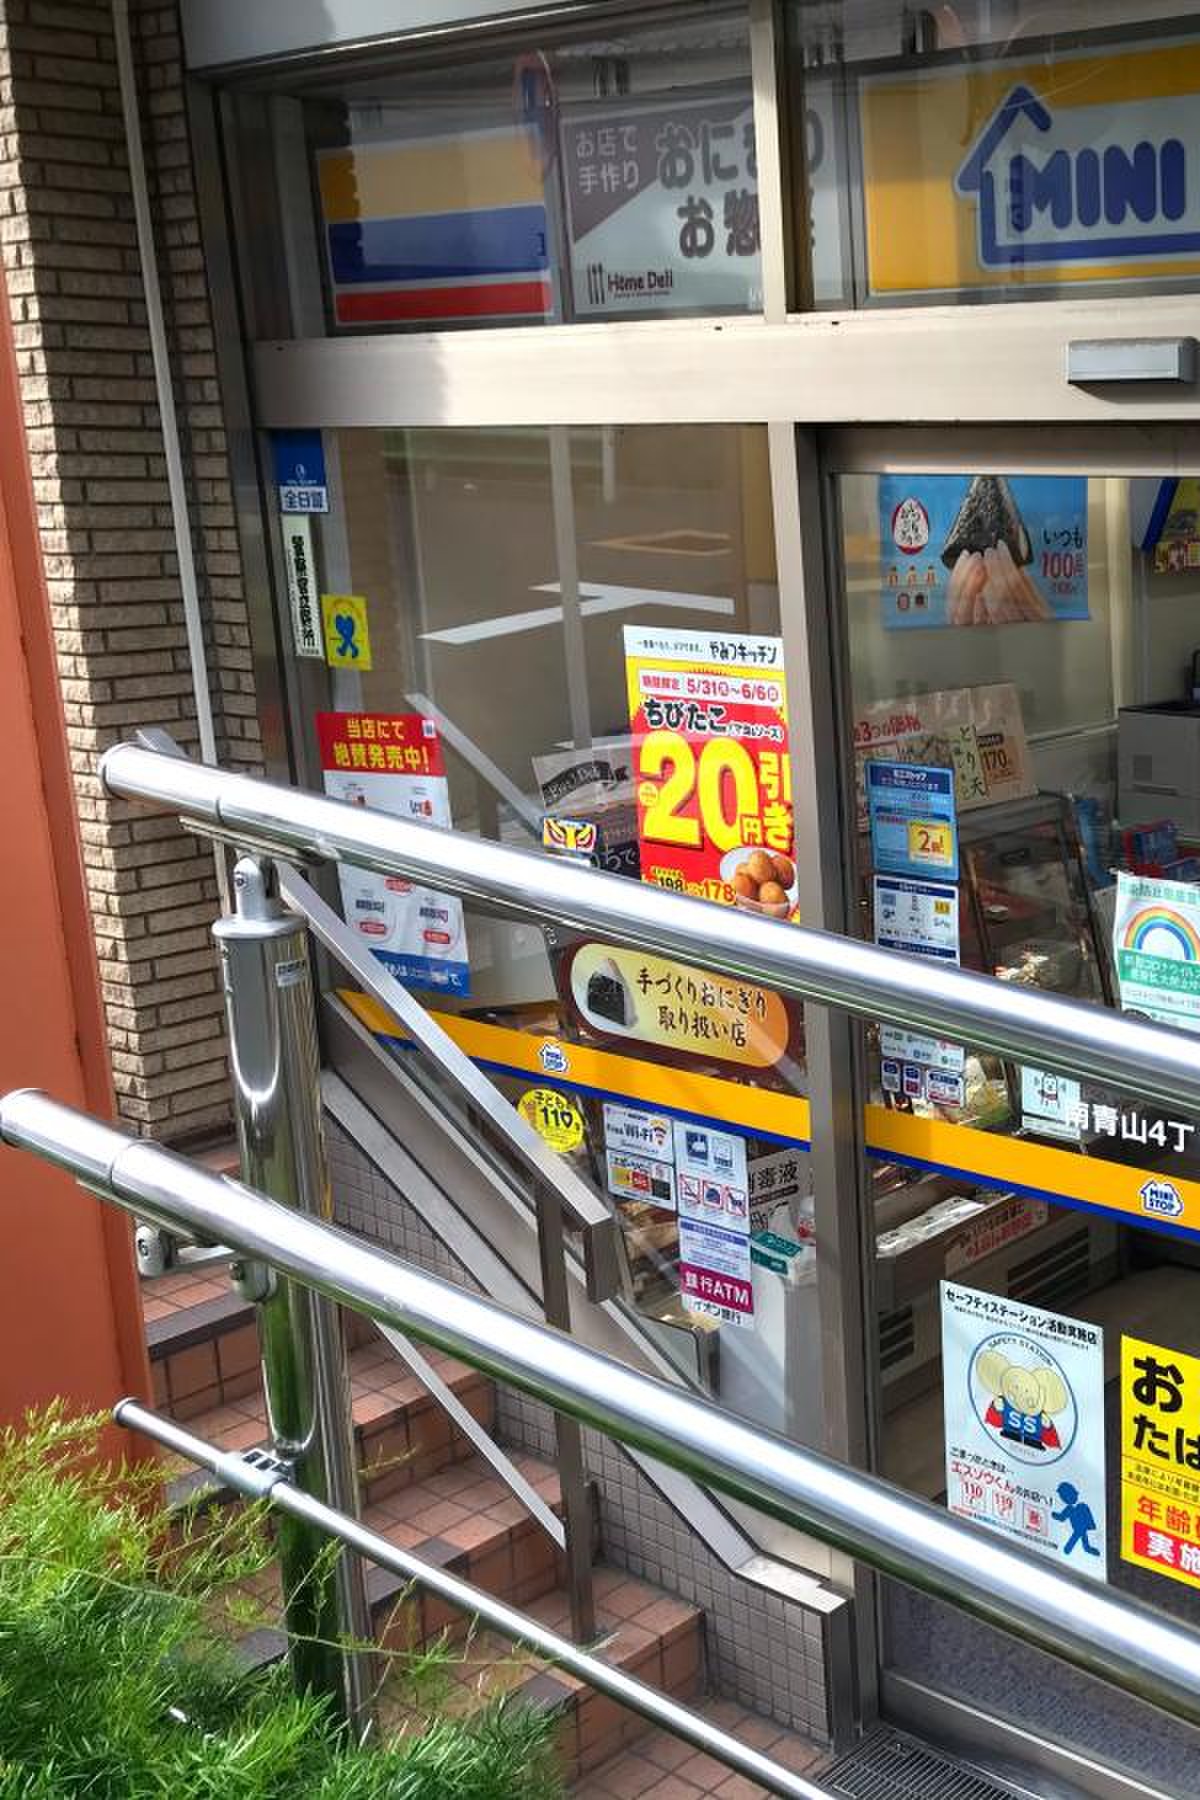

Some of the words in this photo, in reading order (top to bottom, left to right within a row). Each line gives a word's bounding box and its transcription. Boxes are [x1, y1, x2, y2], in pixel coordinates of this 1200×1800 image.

[576, 126, 637, 158] お店で
[578, 160, 639, 194] 手作り
[1010, 139, 1187, 233] MINI
[608, 274, 643, 293] Home
[647, 269, 673, 289] Deli
[1043, 526, 1083, 549] いつも
[709, 639, 777, 664] やみつキッチン
[346, 717, 405, 740] 当店にて
[644, 698, 727, 732] ちびたこ
[983, 749, 1008, 771] 170
[639, 729, 759, 853] 20
[741, 817, 763, 845] 円
[704, 879, 735, 903] 178
[636, 968, 769, 1018] 手づくりおにぎり
[658, 1005, 747, 1047] 取り扱い店
[540, 1106, 574, 1129] 110
[624, 1122, 653, 1142] Wi-Fi
[684, 1270, 750, 1306] 銀行ATM
[945, 1289, 1098, 1346] セーフティステーション活動実施店
[1008, 1410, 1037, 1434] SS
